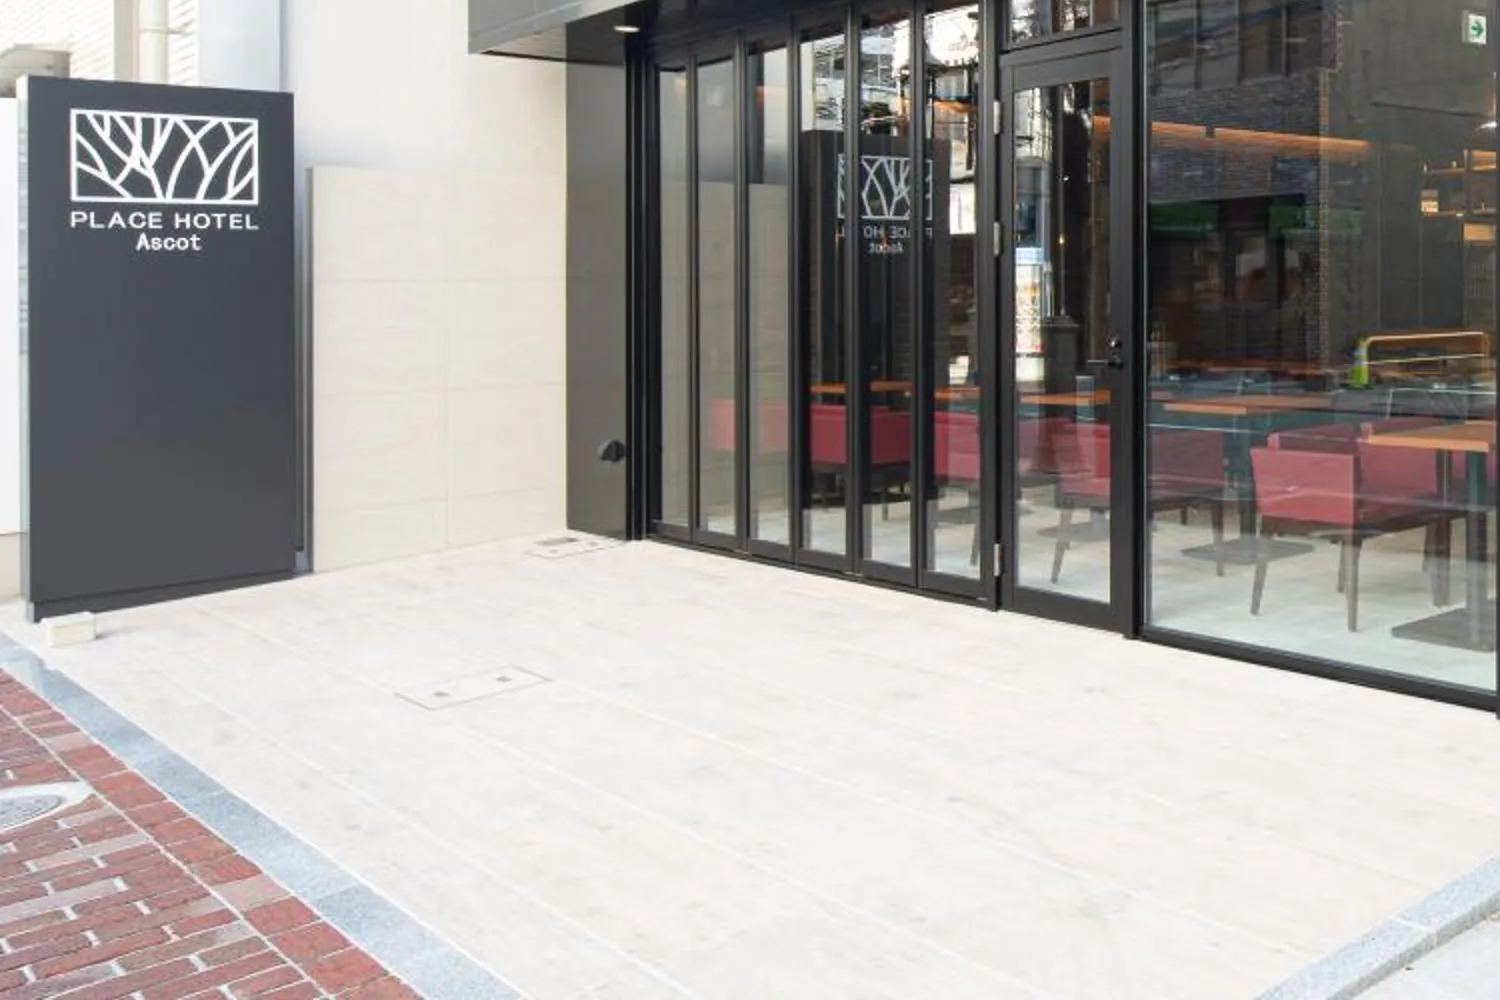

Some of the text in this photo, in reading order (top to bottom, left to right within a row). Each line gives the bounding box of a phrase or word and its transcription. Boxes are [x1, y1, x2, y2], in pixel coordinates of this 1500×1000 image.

[70, 211, 259, 231] PLACE HOTEL
[136, 233, 202, 251] Ascot
